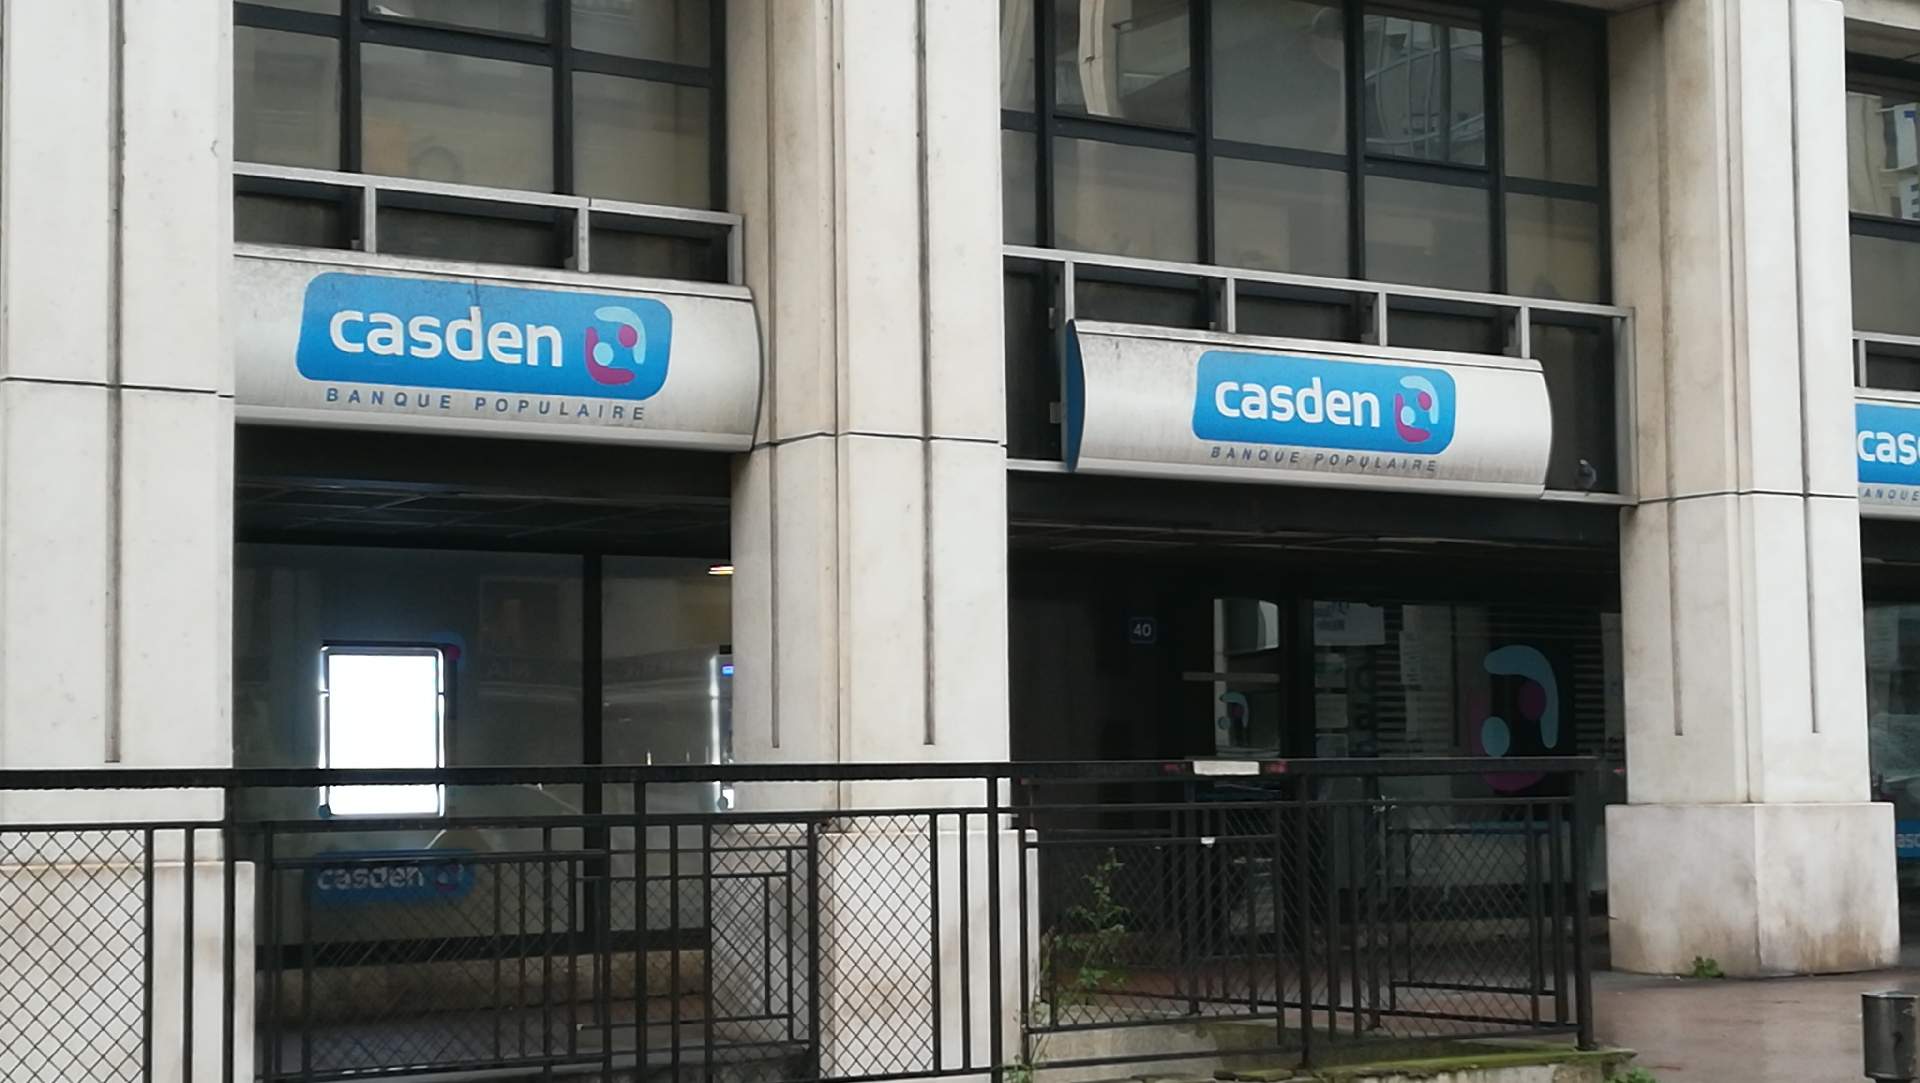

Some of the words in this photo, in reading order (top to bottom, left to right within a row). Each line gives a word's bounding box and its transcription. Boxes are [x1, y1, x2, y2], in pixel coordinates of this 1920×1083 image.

[329, 305, 563, 367] casden
[326, 387, 452, 410] BANQUE
[475, 397, 645, 421] POPULAIRE
[1215, 376, 1381, 428] casden
[1211, 446, 1299, 464] BANQUE
[1314, 453, 1437, 472] POPULAIRE
[1858, 430, 1920, 465] cas
[1863, 488, 1920, 501] ANQUE
[1132, 623, 1152, 637] 40
